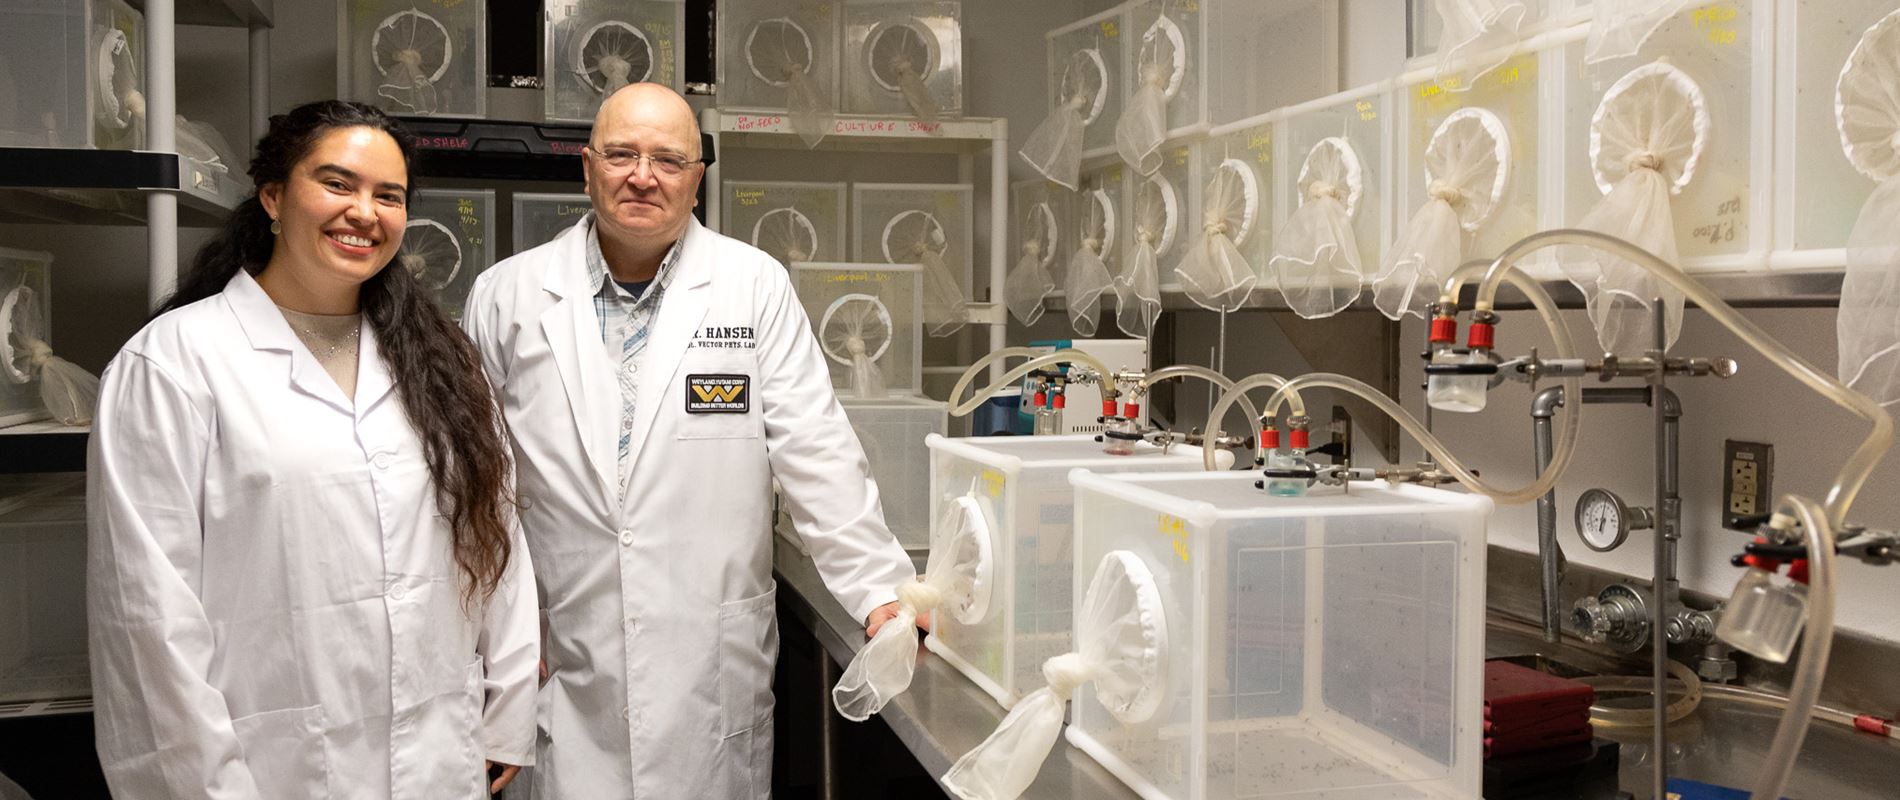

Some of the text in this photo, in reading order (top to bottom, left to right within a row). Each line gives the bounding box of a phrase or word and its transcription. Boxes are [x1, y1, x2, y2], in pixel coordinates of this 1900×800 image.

[835, 121, 895, 133] CULTURE
[706, 327, 754, 339] HANSEN
[698, 341, 723, 349] VECTOR
